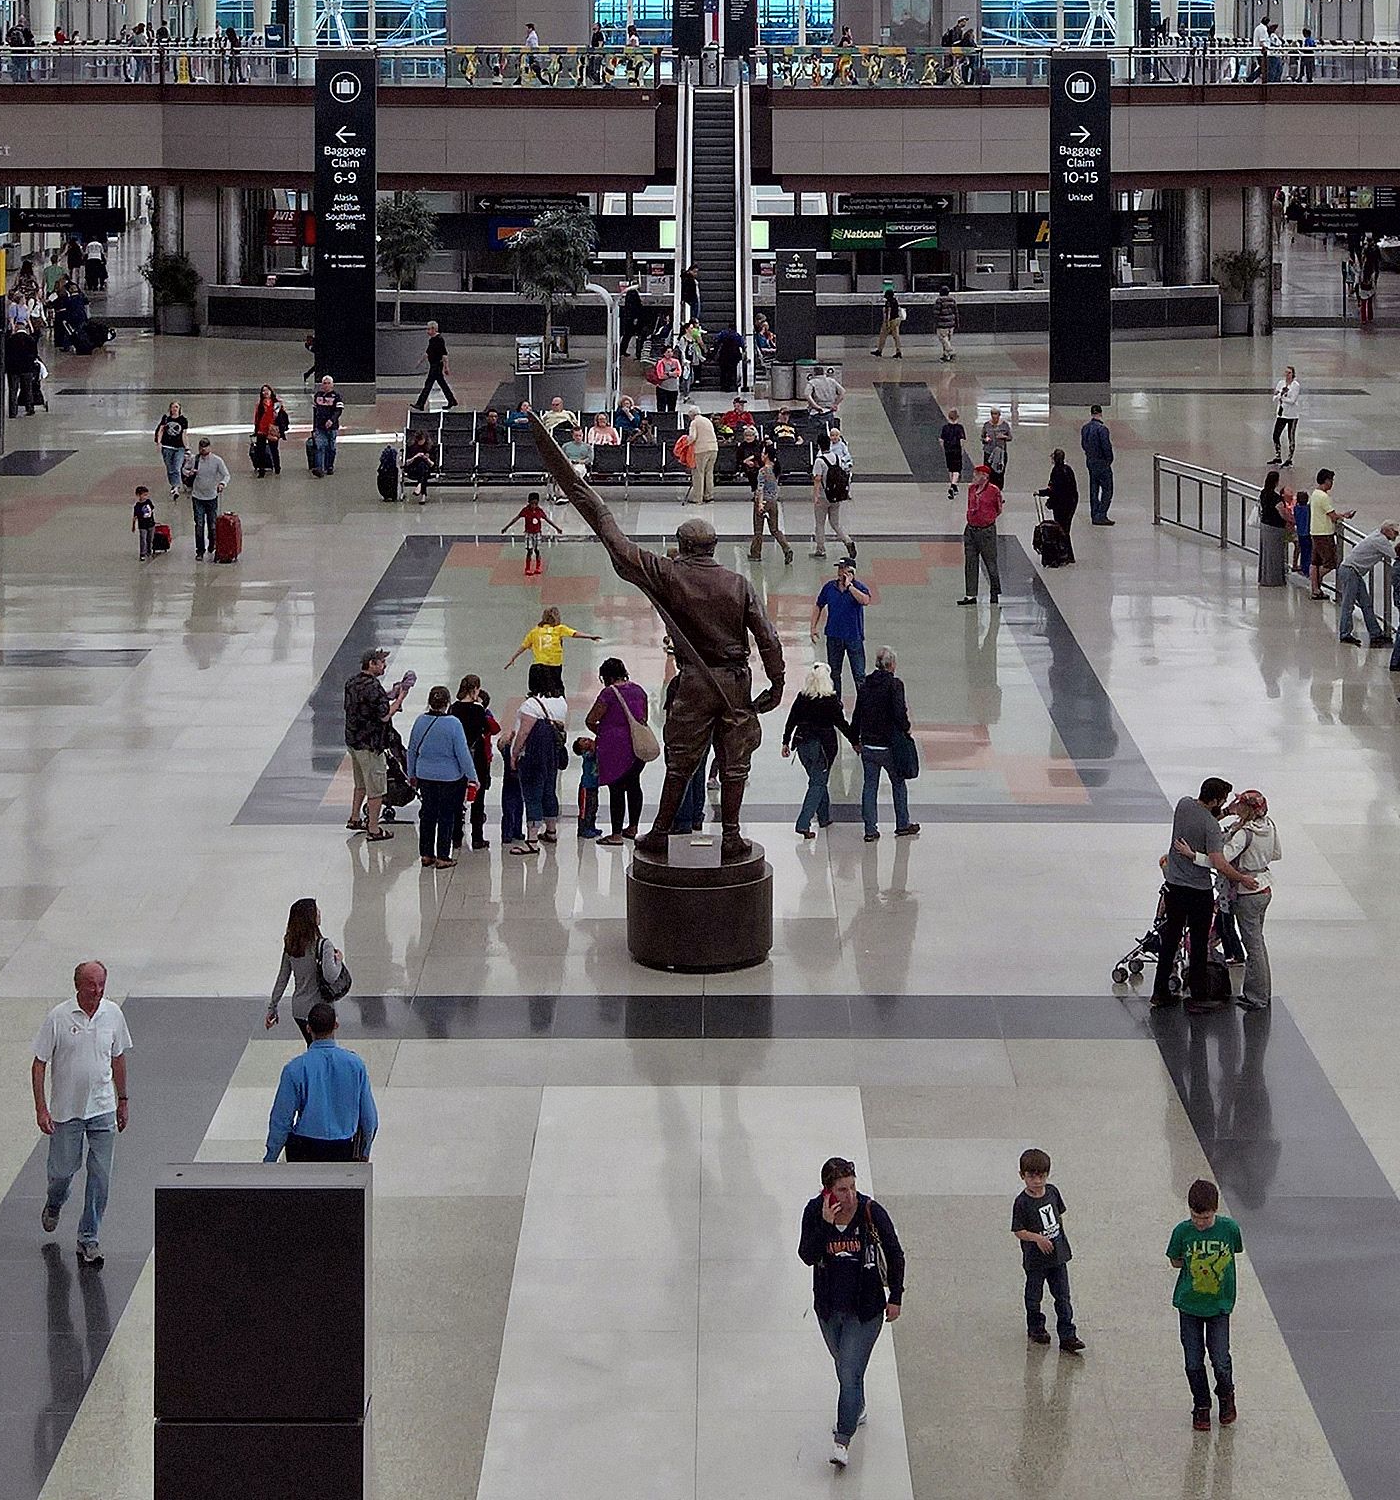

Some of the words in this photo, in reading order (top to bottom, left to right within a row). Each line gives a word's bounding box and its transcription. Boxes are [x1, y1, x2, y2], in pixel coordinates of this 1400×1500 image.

[323, 145, 367, 157] Baggage
[1059, 145, 1102, 157] Baggage
[331, 157, 360, 168] Claim
[1066, 157, 1095, 168] Claim
[333, 171, 357, 184] 6-9
[1062, 171, 1099, 184] 10-15
[333, 193, 359, 201] Alaska
[1067, 192, 1094, 201] United
[331, 203, 361, 211] JetBlue
[272, 210, 295, 221] AVIS
[325, 212, 367, 221] Southwest
[335, 221, 357, 231] Spirit
[887, 223, 935, 232] enterprise
[842, 229, 884, 239] National
